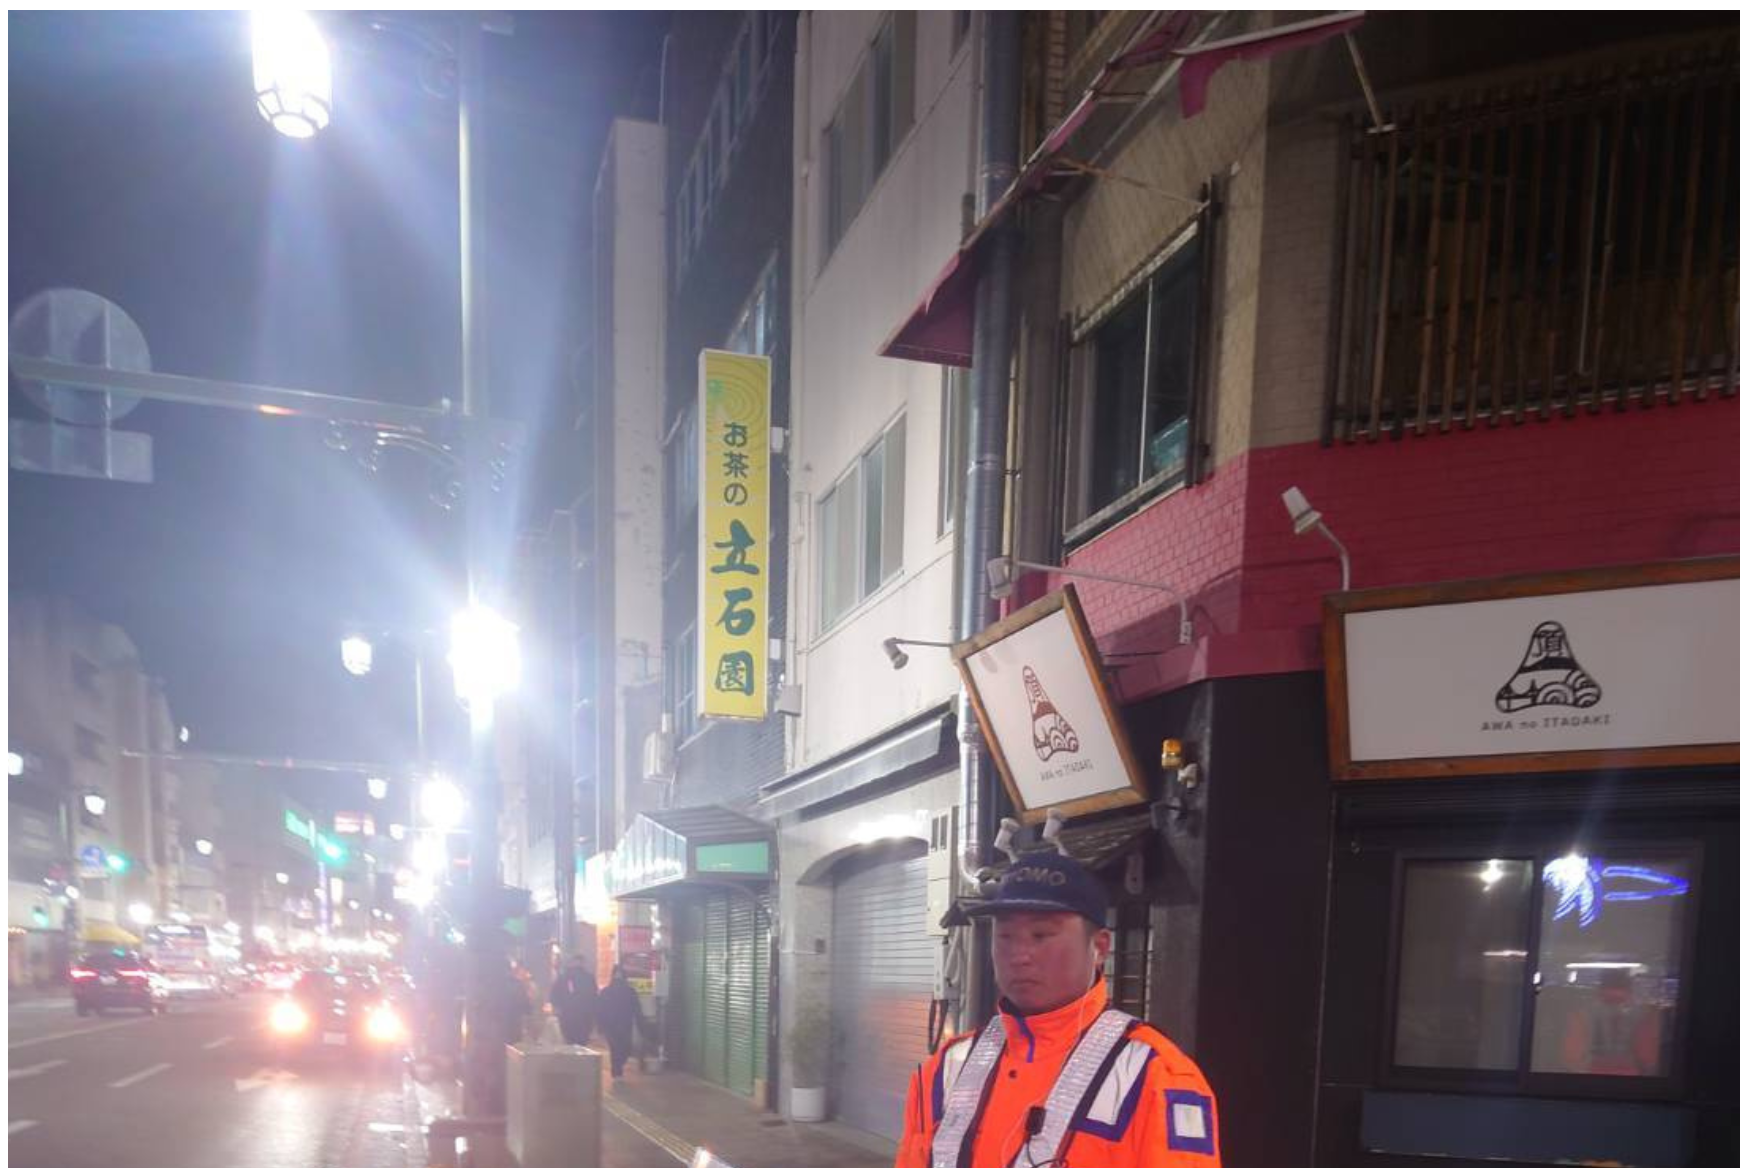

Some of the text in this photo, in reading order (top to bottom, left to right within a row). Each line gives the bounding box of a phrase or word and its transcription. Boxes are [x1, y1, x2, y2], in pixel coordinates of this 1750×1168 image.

[1480, 714, 1611, 731] AWA no ITADAKI
